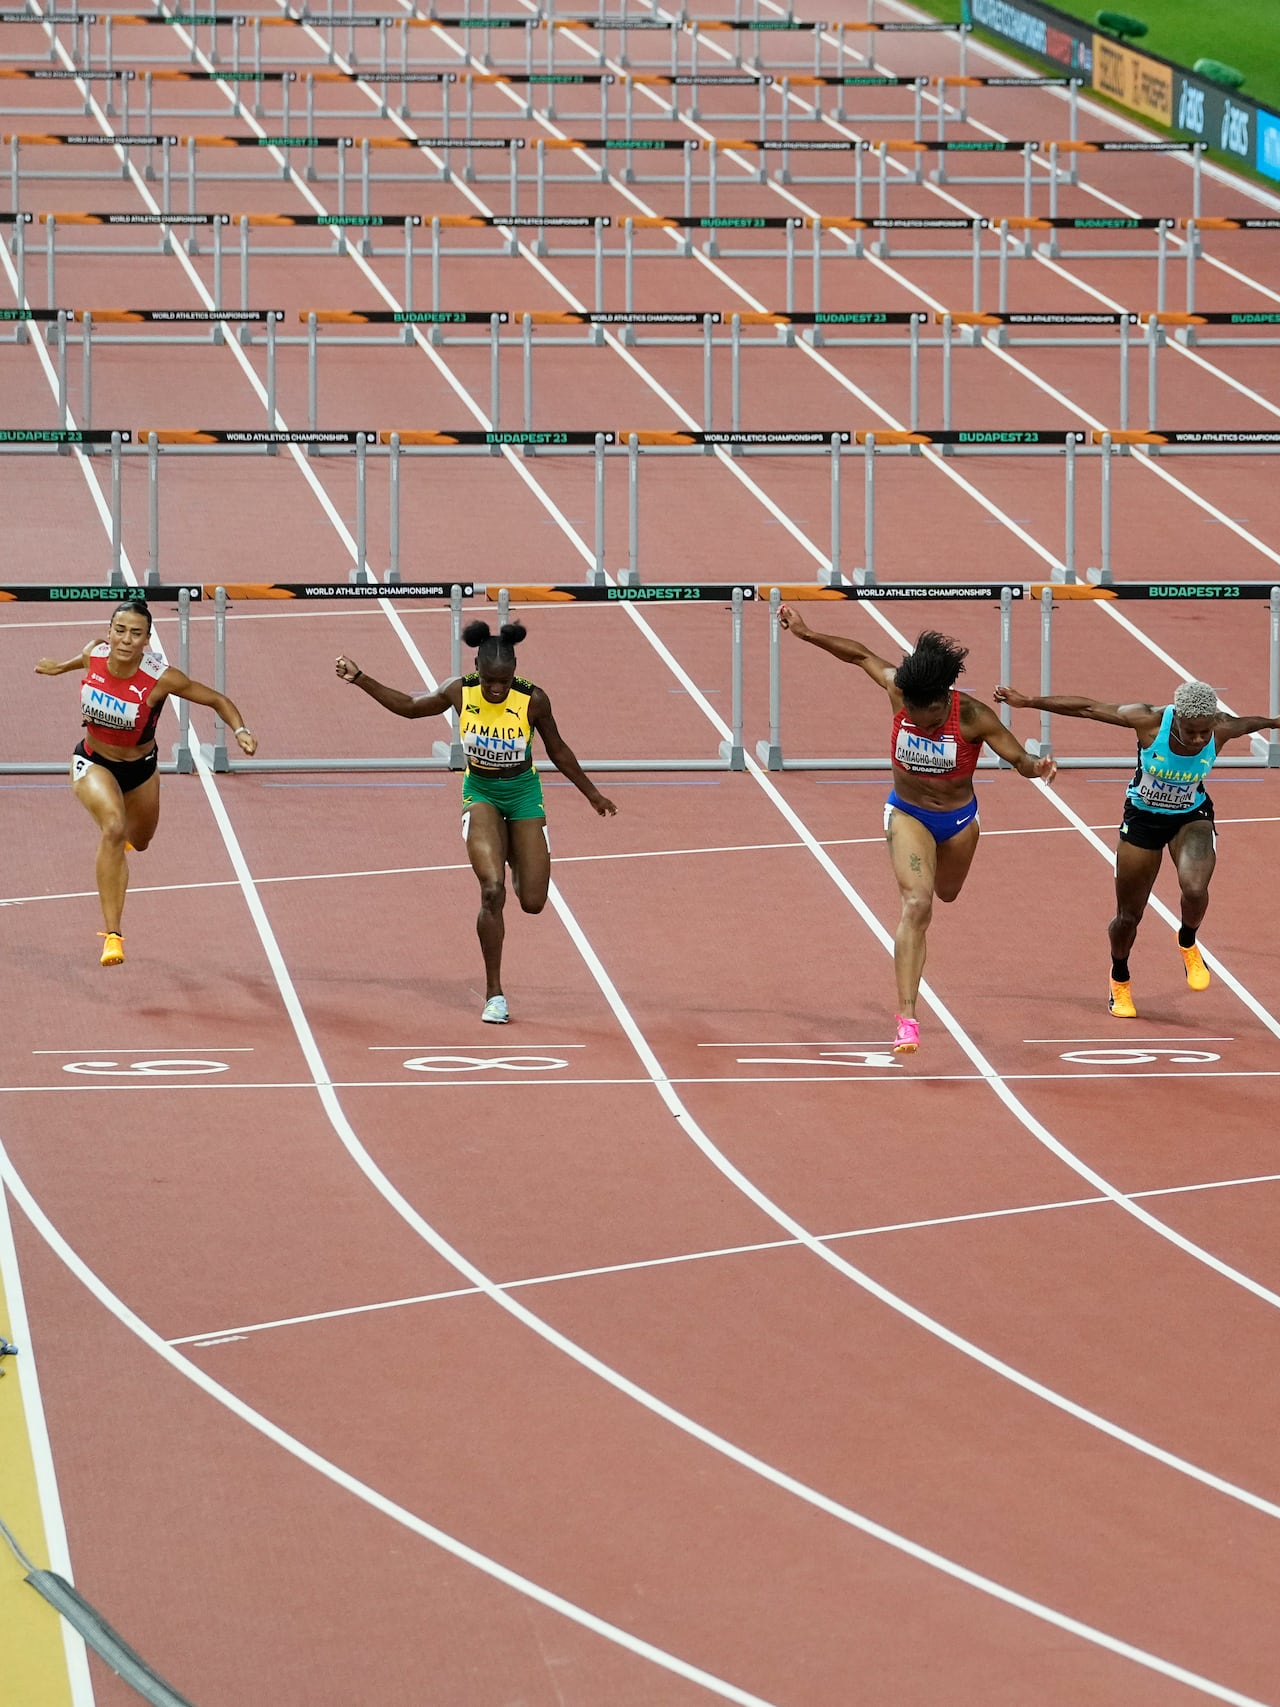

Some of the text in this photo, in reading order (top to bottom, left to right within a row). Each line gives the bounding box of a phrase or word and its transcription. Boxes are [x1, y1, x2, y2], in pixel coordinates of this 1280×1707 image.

[395, 313, 466, 322] BUDAPEST 23
[816, 313, 886, 323] BUDAPEST 23
[0, 431, 82, 441] BUDAPEST 23
[227, 433, 348, 441] WORLD ATHLETICS CHAMPIONSHIPS
[487, 432, 567, 442] BUDAPEST 23
[705, 434, 823, 442] WORLD ATHLETICS CHAMPIONSHIPS
[960, 432, 1038, 442] BUDAPEST 23
[1176, 433, 1200, 441] WORLD
[1201, 433, 1237, 441] ATHLETICS
[50, 587, 145, 599] BUDAPEST 23
[306, 587, 443, 596] WORLD ATHLETICS CHAMPIONSHIPS
[607, 587, 701, 599] BUDAPEST 23
[857, 588, 991, 597] WORLD ATHLETICS CHAMPIONSHIPS
[1149, 586, 1240, 597] BUDAPEST 23
[91, 689, 127, 715] NTN
[463, 722, 524, 740] JAMAICA
[475, 735, 515, 751] NTN
[907, 735, 945, 756] NTN
[468, 745, 520, 761] NUGENT
[897, 747, 954, 768] CAMACHO-QUINN
[1149, 765, 1207, 782] BAHAMAS
[1152, 779, 1190, 794] NTN
[1140, 785, 1193, 803] CHARLTON
[1059, 1048, 1221, 1064] 6
[62, 1059, 230, 1076] 9
[403, 1056, 569, 1072] 8
